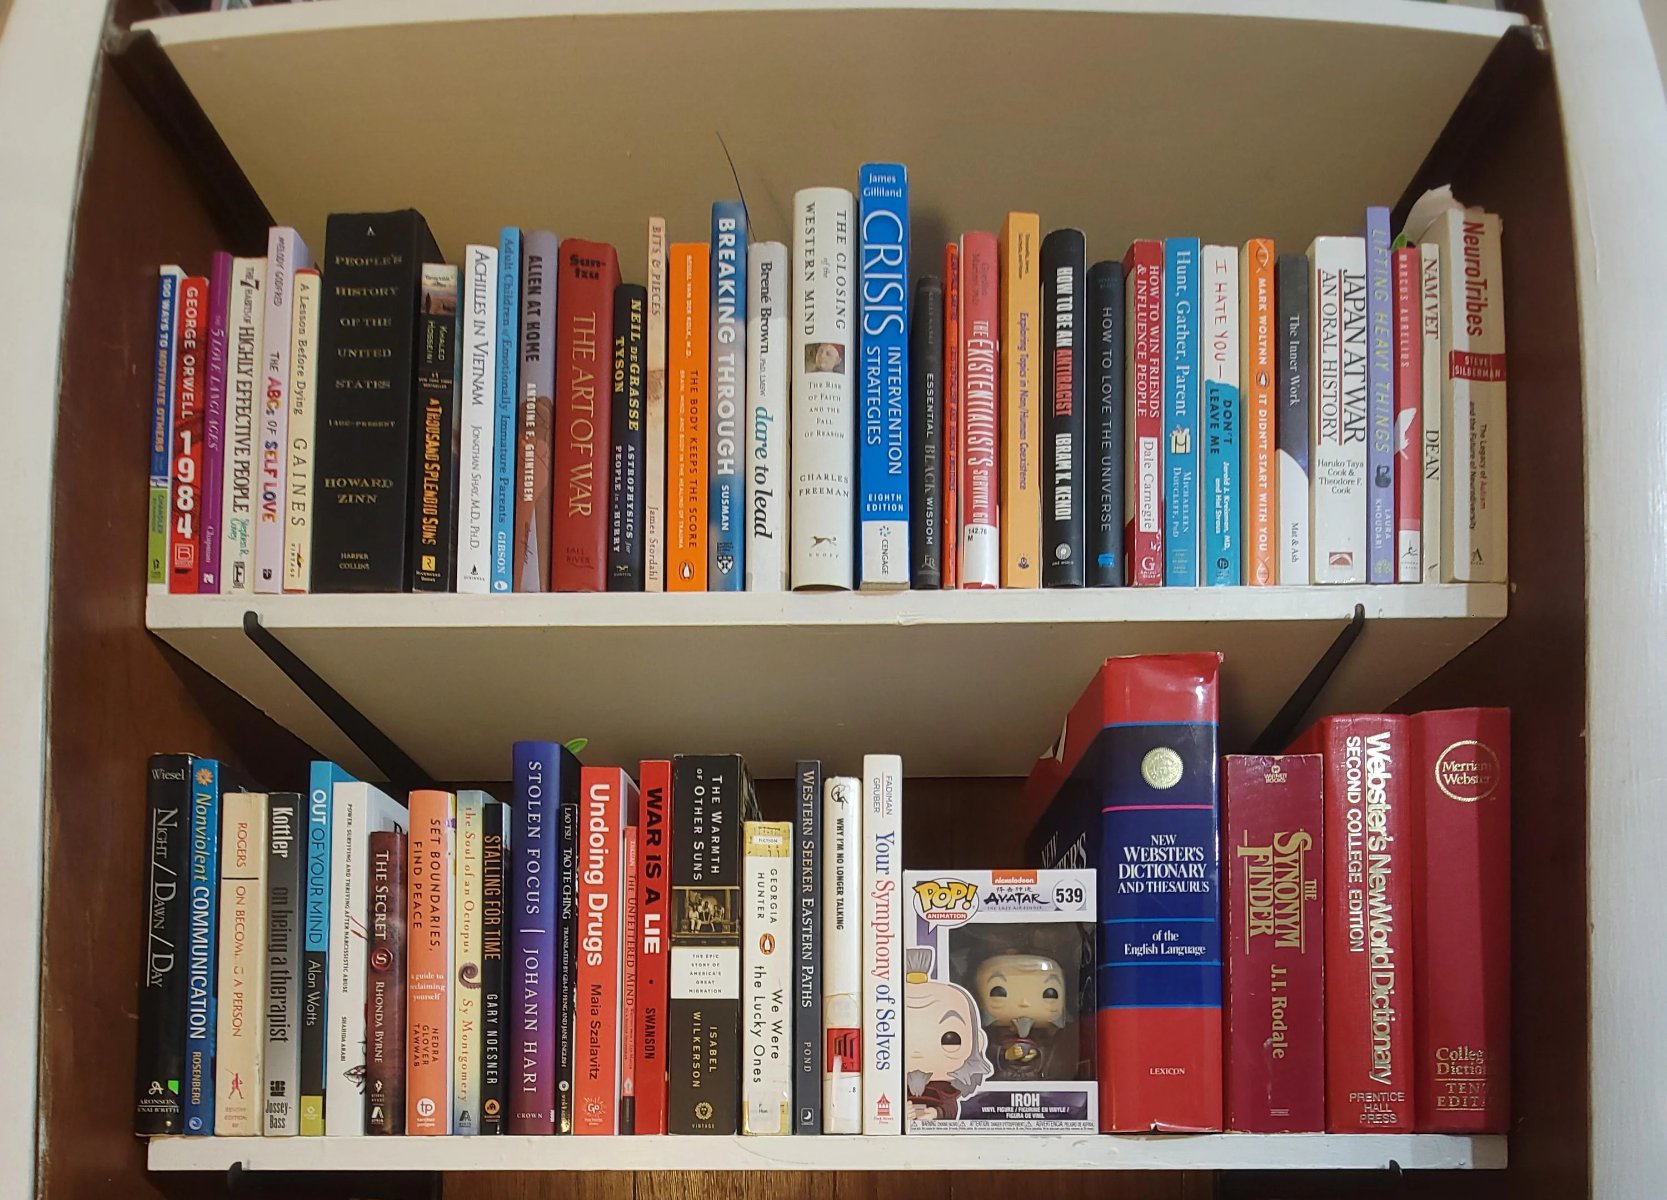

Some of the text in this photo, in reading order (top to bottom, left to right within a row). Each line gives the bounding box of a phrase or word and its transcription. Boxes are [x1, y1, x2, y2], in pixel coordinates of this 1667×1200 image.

[863, 188, 902, 198] Gilliland
[869, 173, 896, 185] James
[863, 209, 905, 337] CRISIS
[1463, 221, 1489, 338] NeuroTribes
[471, 250, 490, 407] ACHILLES IN VIETNAM
[760, 262, 773, 354] Brené Brown
[1174, 250, 1191, 417] Hunt, Gather, Parent
[182, 286, 199, 419] GEORGE ORWELL
[269, 352, 280, 373] THE
[717, 218, 736, 476] BREAKING THROUGH
[1321, 271, 1338, 442] AN ORAL HISTORY
[1343, 269, 1366, 445] JAPAN AT WAR
[568, 312, 597, 518] THE ART OF WAR
[866, 346, 881, 446] STRATEGIES
[887, 346, 902, 475] INTERVENTION
[1101, 307, 1113, 532] HOW TO LOVE THE UNIVERSE
[267, 420, 279, 437] OF
[177, 429, 195, 539] 1984
[264, 441, 279, 479] SELF
[291, 439, 308, 527] GAINES
[754, 406, 774, 540] dare to lead
[1142, 441, 1155, 530] Dale Carnegie
[262, 482, 277, 523] LOVE
[721, 485, 730, 532] SUSMAN
[866, 504, 904, 512] EDITION
[868, 493, 902, 502] EIGHTH
[880, 539, 889, 576] CENGAGE
[151, 768, 185, 781] Wiesel
[872, 777, 880, 813] GRUBER
[885, 775, 893, 816] FADIMAN
[525, 761, 541, 915] STOLEN FOCUS
[1122, 846, 1204, 862] WEBSTER'S
[1150, 834, 1177, 846] NEW
[308, 789, 327, 945] OUT OF YOUR MIND
[582, 783, 610, 967] Undoing Drugs
[644, 787, 663, 955] WAR IS A LIE
[1117, 881, 1210, 893] AND THESAURUS
[1118, 863, 1207, 880] DICTIONARY
[1236, 844, 1274, 938] FINDER
[1273, 830, 1313, 948] SYNONYM
[190, 792, 213, 1040] Nonviolent COMMUNICATION
[912, 881, 979, 911] POP!
[926, 912, 967, 920] ANIMATION
[983, 891, 1050, 904] AVATAR
[1055, 888, 1084, 903] 539
[871, 830, 896, 1071] Your Symphony of Selves
[1124, 944, 1206, 957] English Language
[1152, 929, 1179, 942] of the
[306, 960, 320, 1026] Alan Watts
[522, 948, 539, 1093] JOHANN HARI
[644, 1008, 656, 1061] SWANSON
[750, 966, 767, 1083] the Lucky Ones
[770, 989, 783, 1060] We Were
[692, 1011, 701, 1088] WILKERSON
[709, 1025, 718, 1073] ISABEL
[1149, 1067, 1186, 1076] LEXICON
[191, 1051, 202, 1105] ROSENBERG
[1010, 1092, 1040, 1107] IROH
[1349, 1092, 1405, 1102] PRENTICE
[1360, 1113, 1398, 1123] PRESS
[1364, 1103, 1393, 1112] HALL
